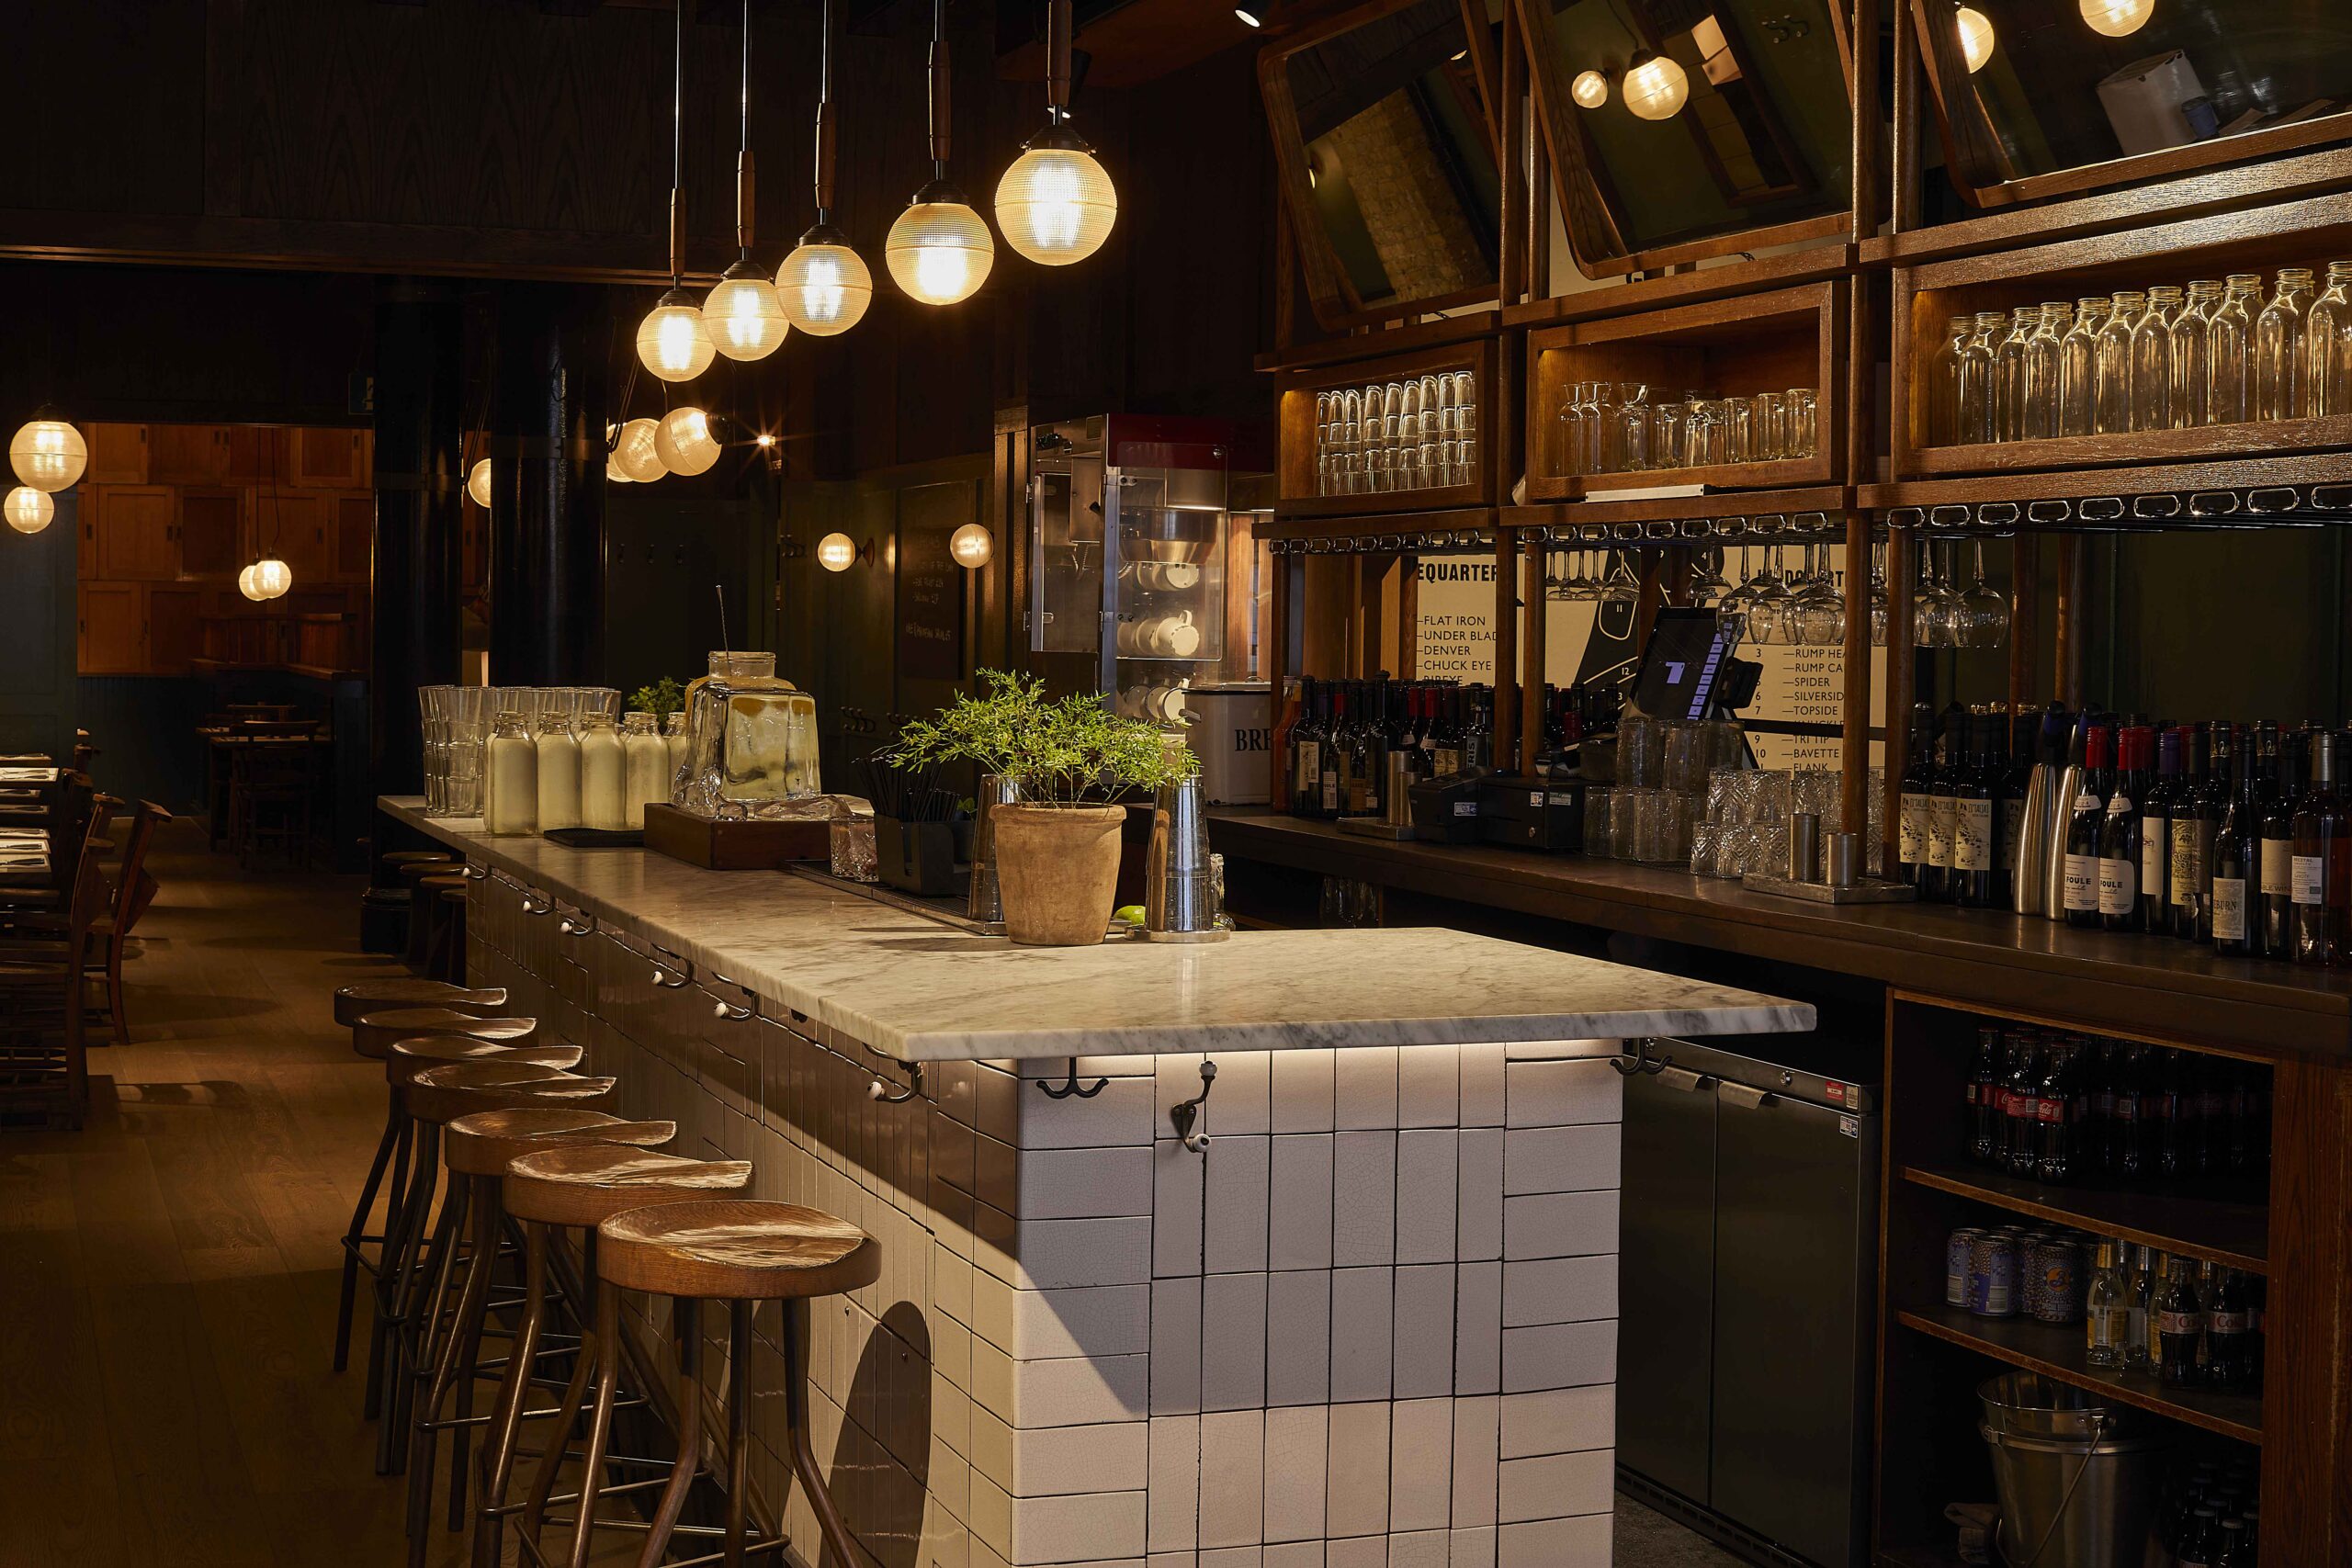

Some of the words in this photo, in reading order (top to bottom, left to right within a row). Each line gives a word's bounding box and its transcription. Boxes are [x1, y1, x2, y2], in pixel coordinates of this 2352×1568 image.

[1616, 604, 1623, 613] 11
[1424, 615, 1452, 626] FLAT
[1456, 615, 1486, 626] IRON
[1424, 630, 1466, 640] UNDER
[1424, 645, 1471, 655] DENVER
[1756, 649, 1761, 658] 3
[1795, 649, 1825, 658] RUMP
[1828, 649, 1845, 658] HE
[1423, 660, 1468, 671] CHUCK
[1472, 660, 1491, 671] EYE
[1795, 663, 1825, 672] RUMP
[1622, 667, 1630, 675] 12
[1794, 678, 1830, 687] SPIDER
[1756, 692, 1761, 701] 6
[1756, 706, 1761, 715] 7
[1793, 705, 1838, 716] TOPSIDE
[1754, 735, 1760, 744] 9
[1756, 749, 1766, 758] 10
[1793, 749, 1839, 758] BAVETTE
